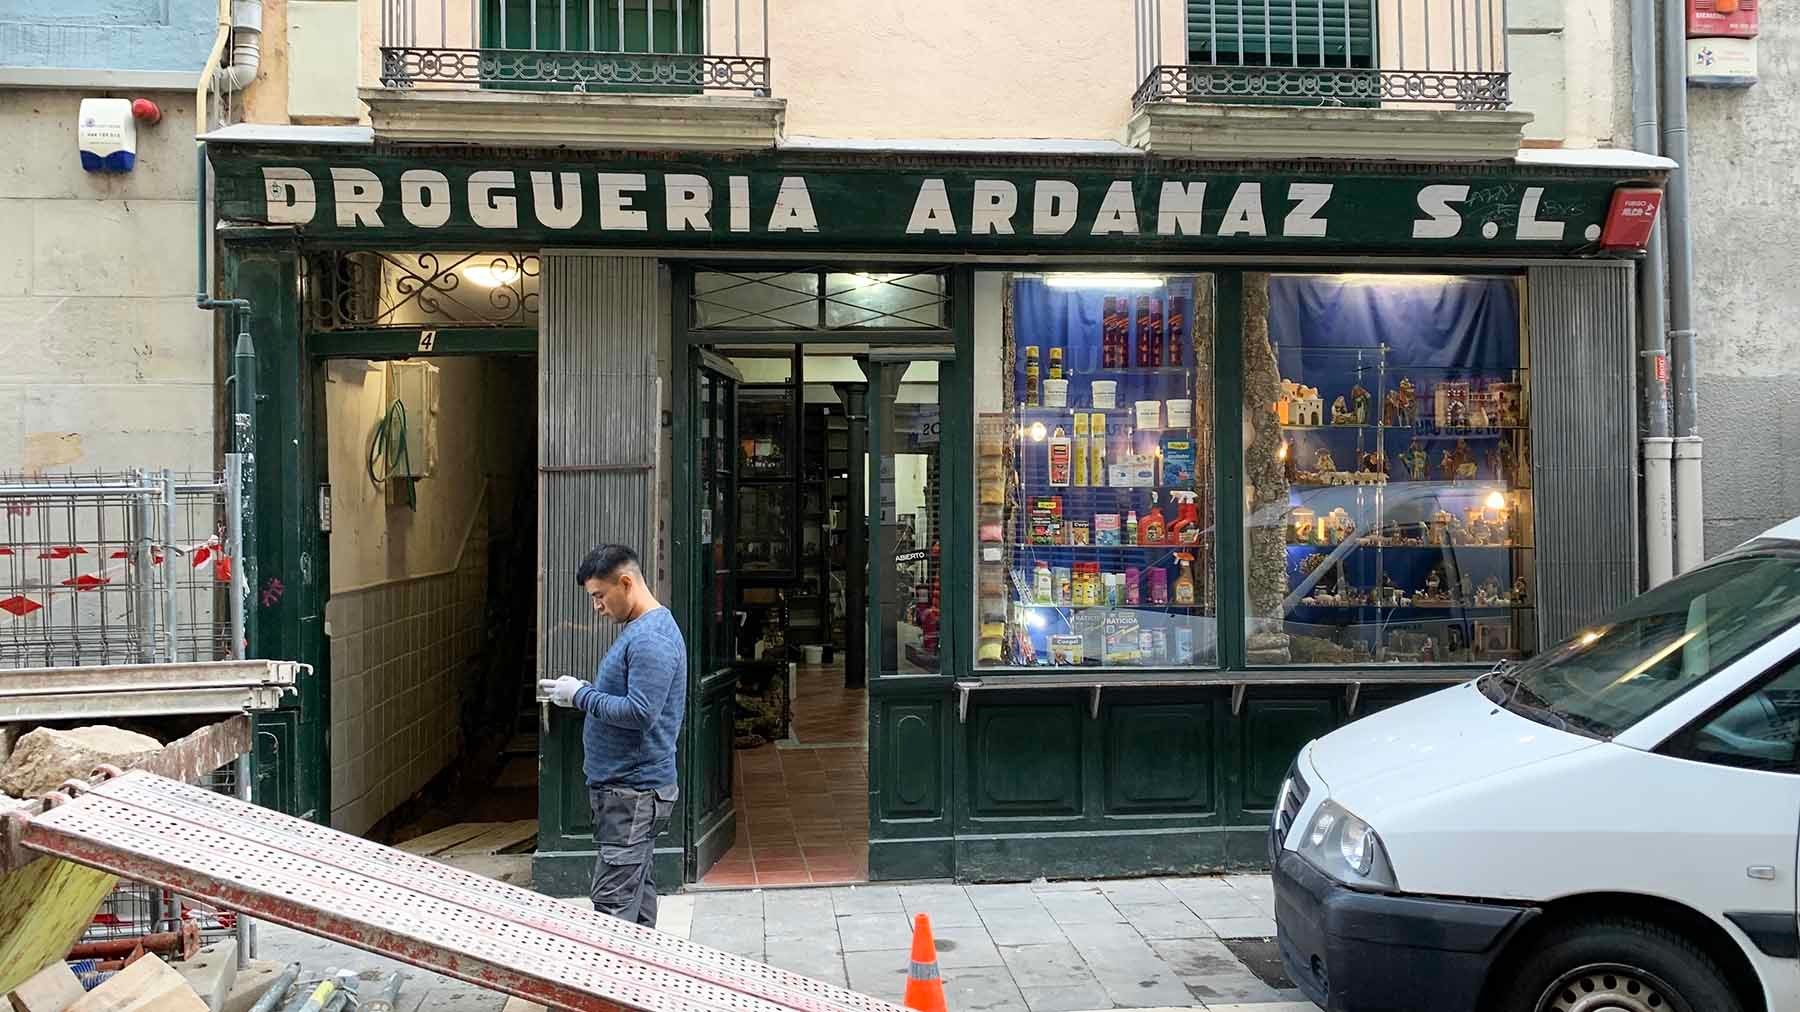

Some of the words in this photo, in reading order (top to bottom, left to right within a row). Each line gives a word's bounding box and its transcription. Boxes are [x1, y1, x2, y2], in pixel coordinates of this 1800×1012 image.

[262, 167, 819, 233] DROGUERIA
[906, 178, 1333, 238] ARDANAZ
[1412, 184, 1601, 242] S.L.
[421, 332, 432, 349] 4
[895, 551, 925, 563] ABIERTO
[1106, 617, 1138, 625] RATICIDA
